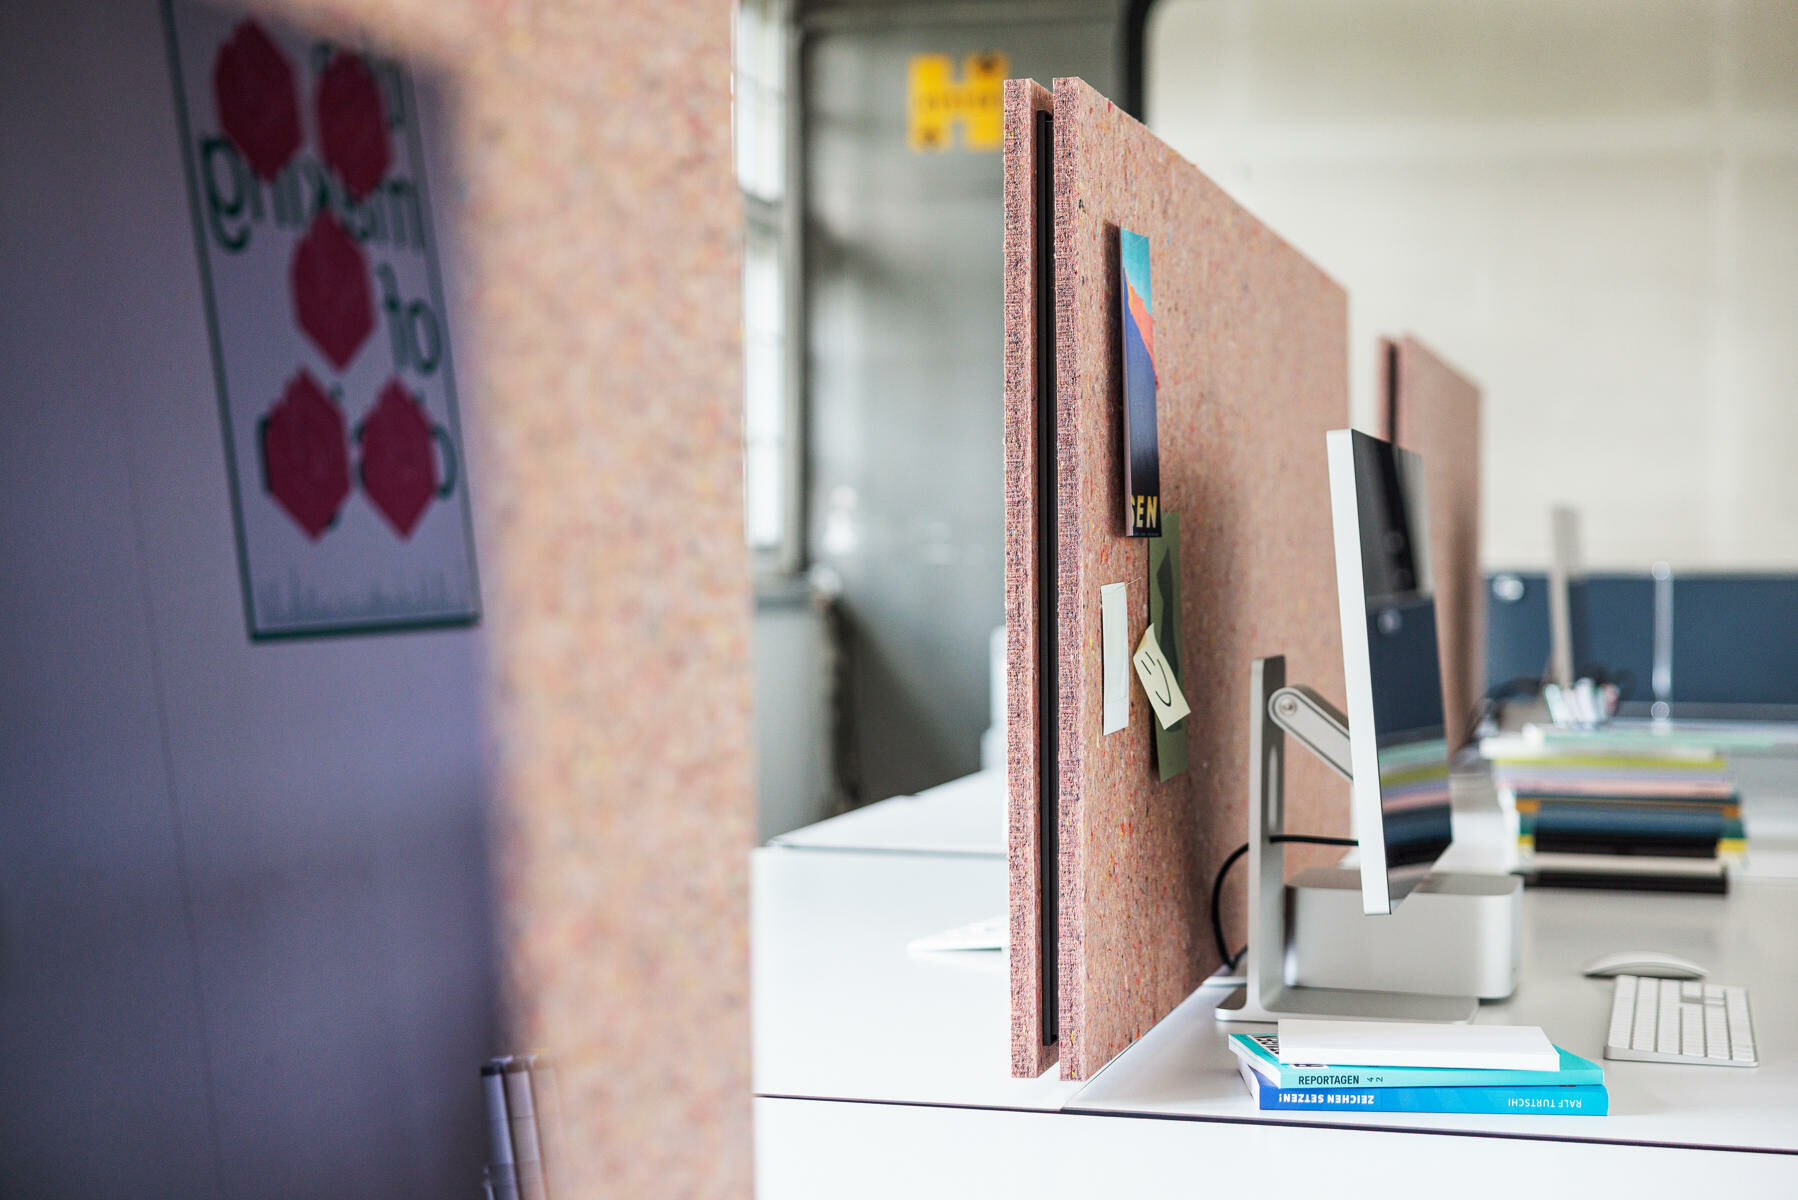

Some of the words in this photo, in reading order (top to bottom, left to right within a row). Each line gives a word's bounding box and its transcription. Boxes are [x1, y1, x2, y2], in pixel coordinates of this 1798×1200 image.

[1298, 1075, 1360, 1085] REPORTAGEN
[1278, 1093, 1324, 1104] SETZEN!
[1327, 1094, 1375, 1105] ZEICHEN
[1507, 1098, 1556, 1108] TURTSCHI
[1558, 1099, 1582, 1109] RALF
